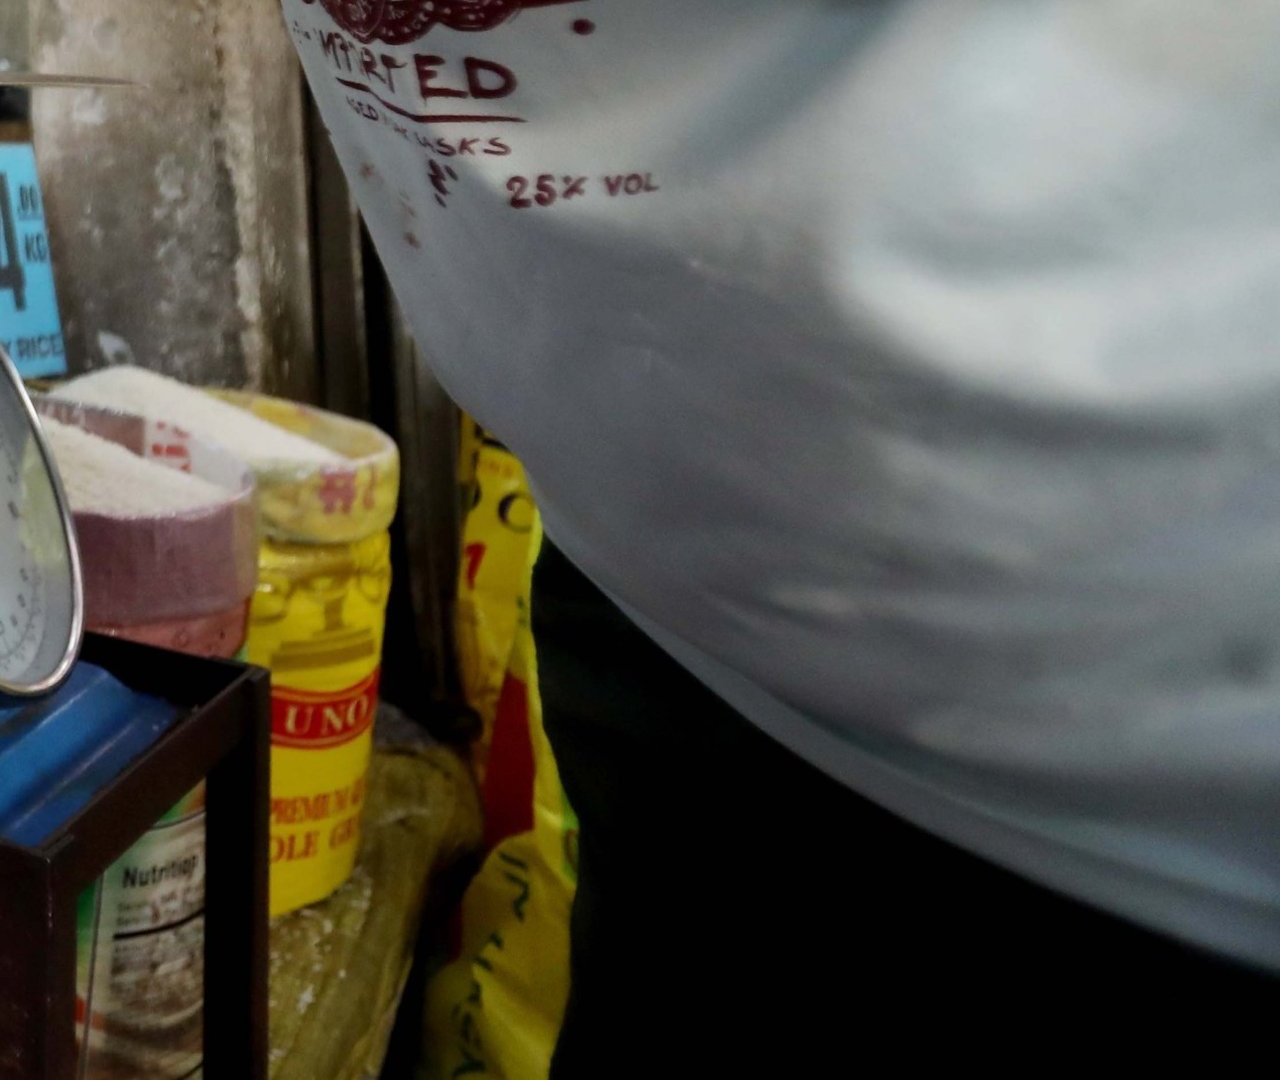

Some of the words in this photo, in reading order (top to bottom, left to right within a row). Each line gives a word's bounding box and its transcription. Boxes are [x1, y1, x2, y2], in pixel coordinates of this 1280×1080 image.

[604, 169, 661, 198] VOL
[17, 333, 65, 358] RICE
[284, 693, 370, 734] UNO
